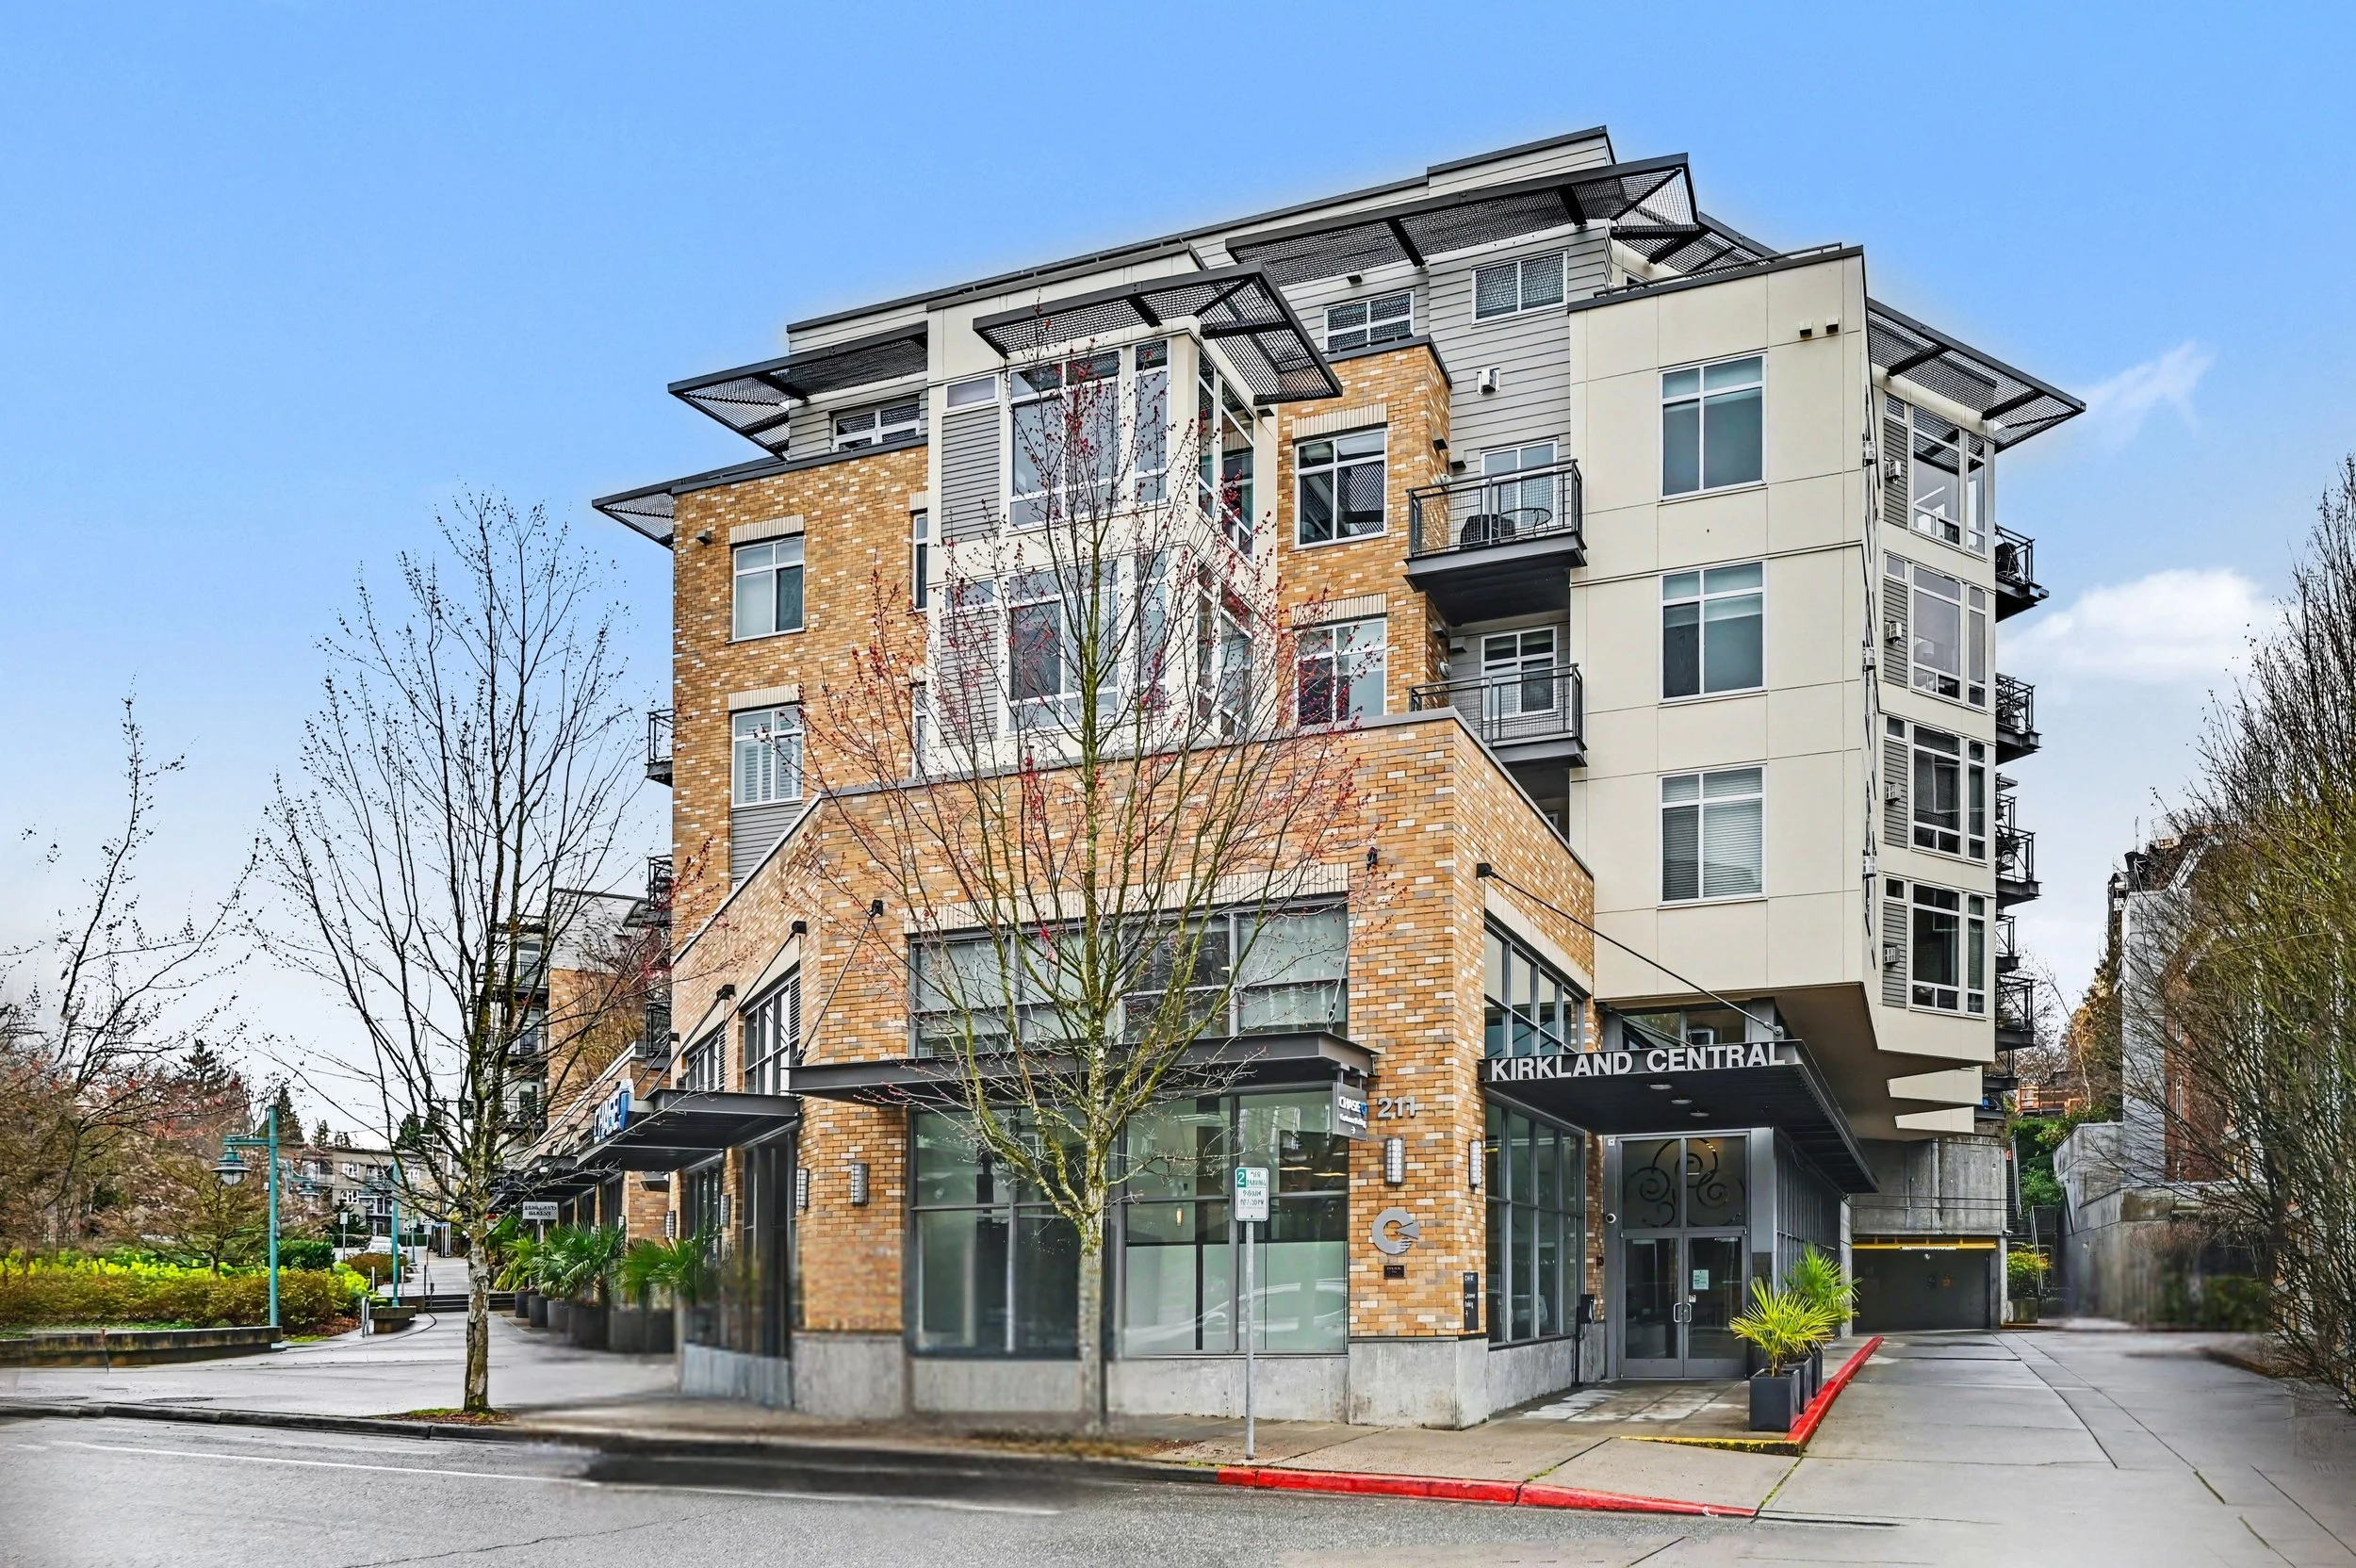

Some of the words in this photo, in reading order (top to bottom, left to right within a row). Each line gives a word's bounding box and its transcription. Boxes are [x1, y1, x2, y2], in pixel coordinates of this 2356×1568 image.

[1491, 1052, 1633, 1082] KIRKLAND
[1646, 1042, 1786, 1072] CENTRAL
[1338, 1096, 1361, 1113] CHASE
[1378, 1096, 1415, 1119] 211
[1237, 1171, 1245, 1185] 2
